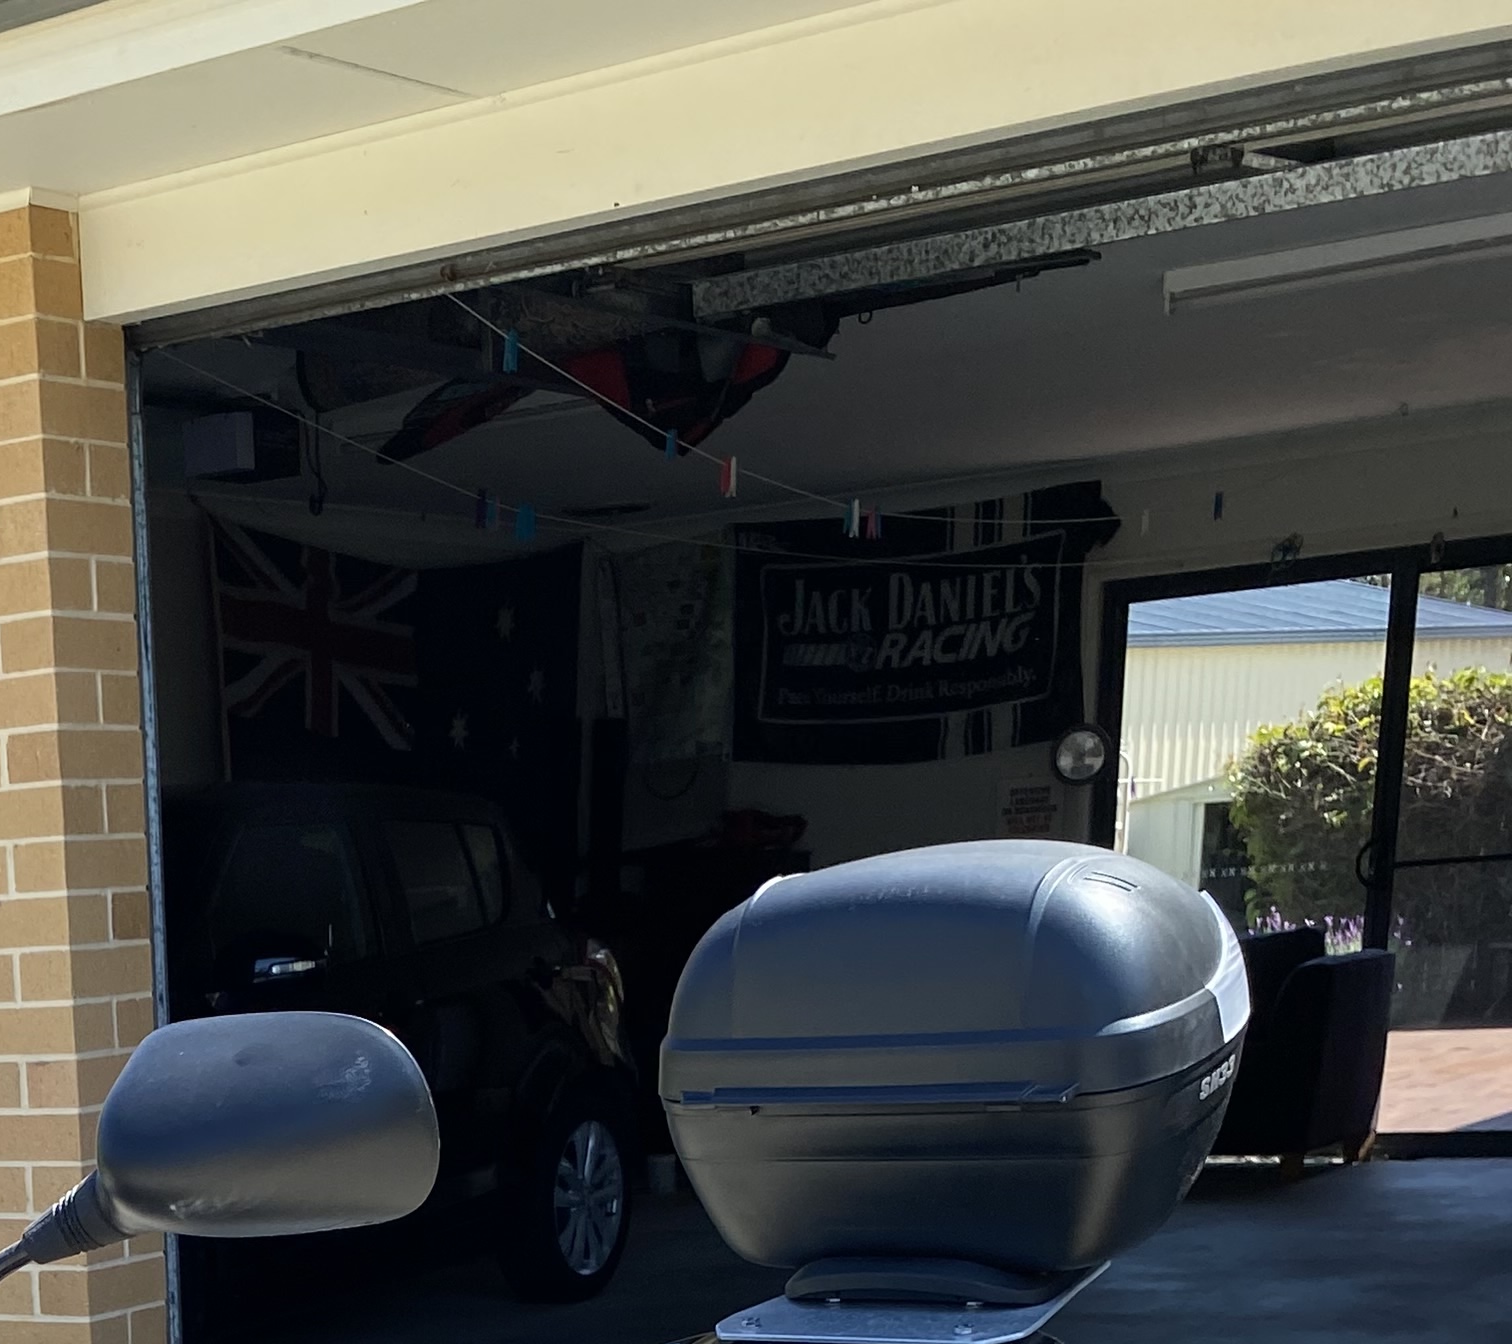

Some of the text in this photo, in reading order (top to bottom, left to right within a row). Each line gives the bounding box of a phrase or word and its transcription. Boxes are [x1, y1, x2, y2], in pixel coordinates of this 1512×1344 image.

[778, 554, 1041, 636] JACK DANIEL'S
[875, 610, 1036, 670] RACING
